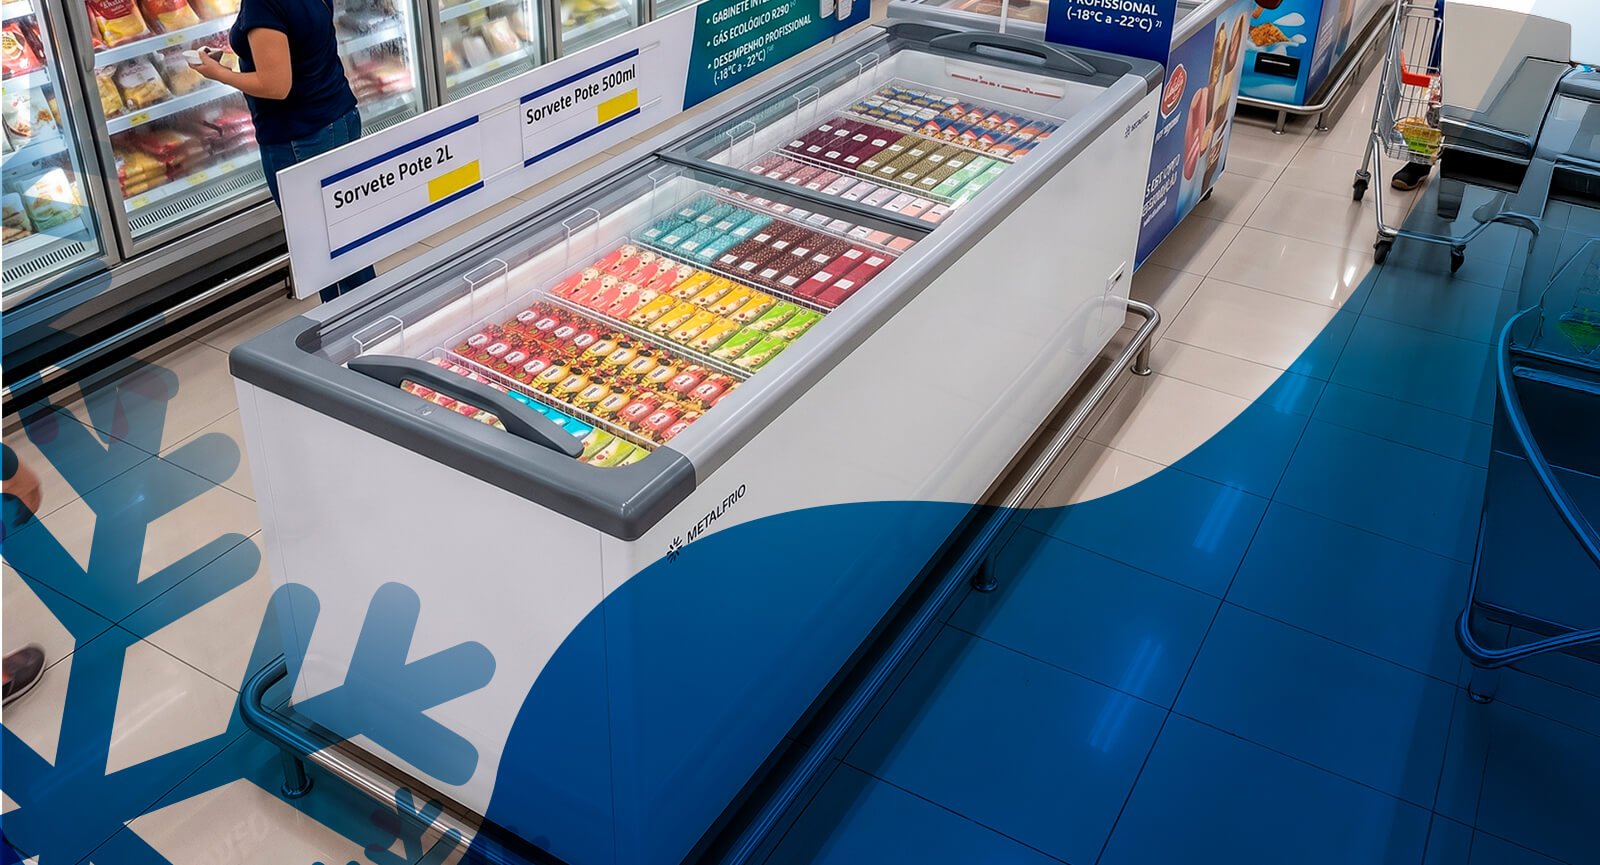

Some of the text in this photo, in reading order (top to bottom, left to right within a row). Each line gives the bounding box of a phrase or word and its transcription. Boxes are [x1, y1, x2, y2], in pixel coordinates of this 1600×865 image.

[713, 0, 750, 25] GABINETE
[713, 3, 790, 47] GÁS ECOLÓGICO R290
[1105, 15, 1112, 24] a
[713, 13, 812, 70] DESEMPENHO PROFISSIONAL
[737, 63, 743, 73] a
[525, 63, 636, 125] Sorvete Pote 500ml
[333, 144, 454, 209] Sorvete Pote 2L
[687, 484, 746, 544] METALFRIO
